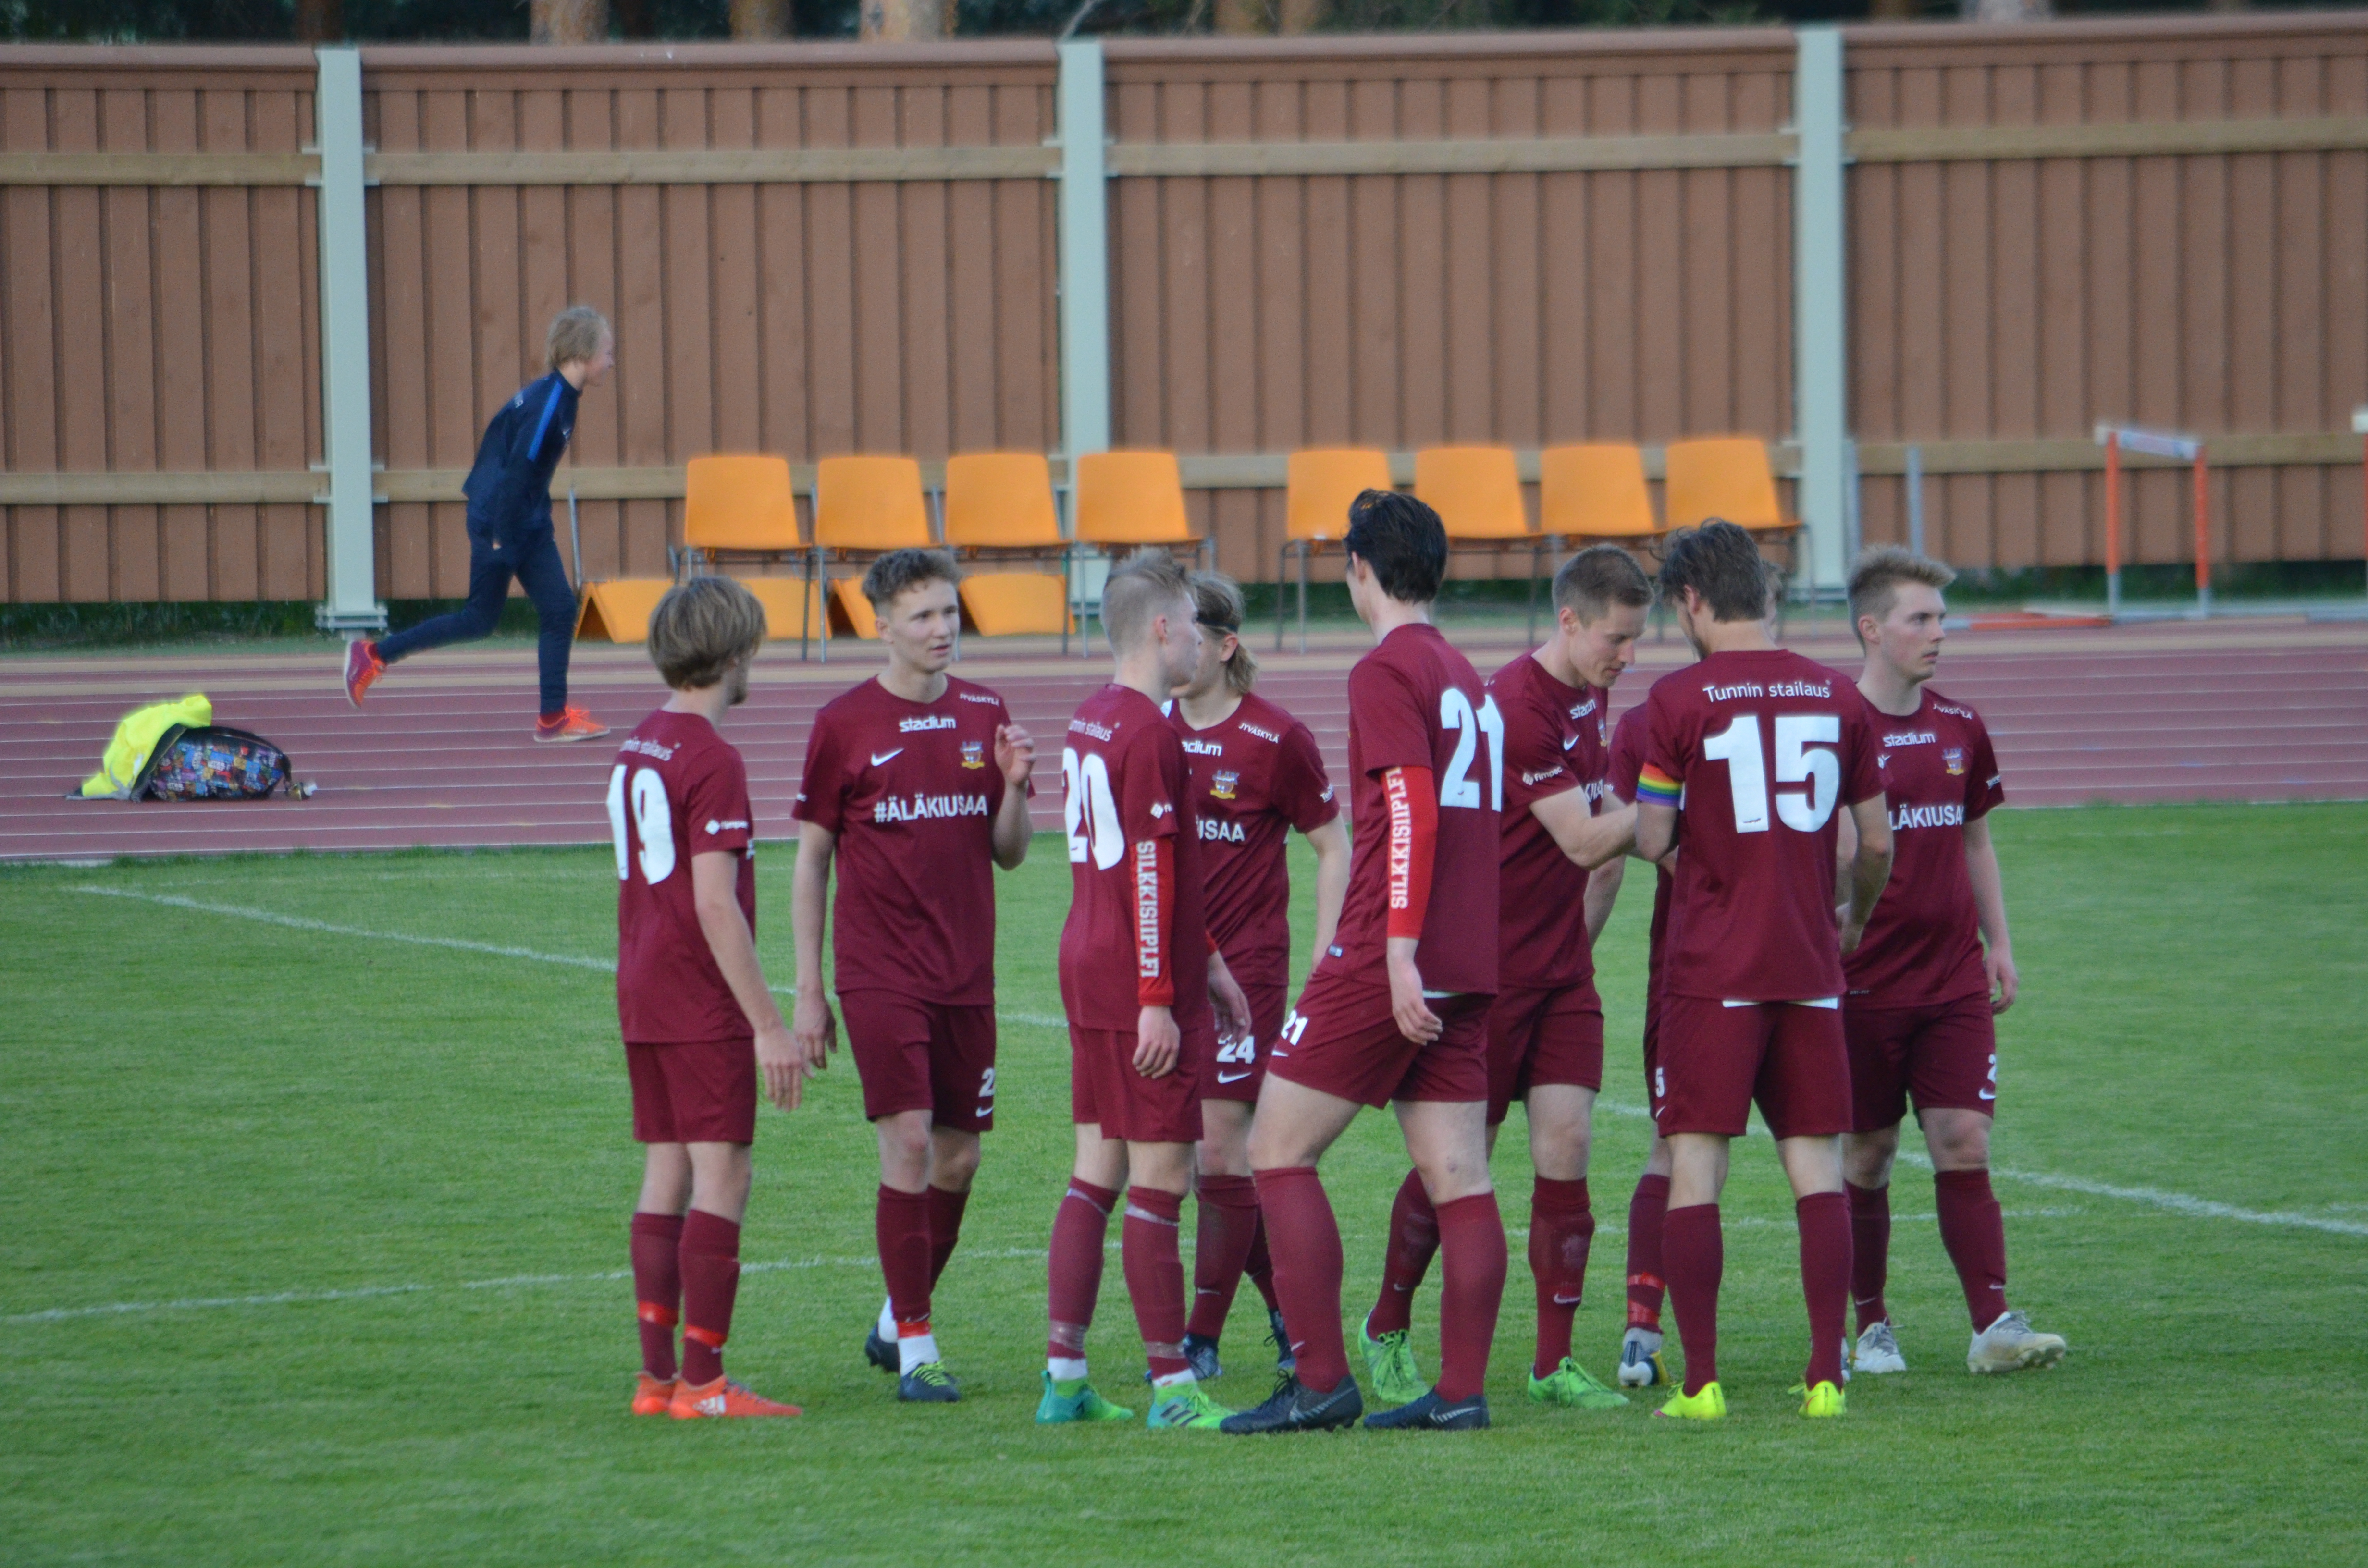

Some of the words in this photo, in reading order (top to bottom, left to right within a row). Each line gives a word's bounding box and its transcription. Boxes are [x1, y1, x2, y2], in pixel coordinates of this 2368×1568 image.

[1702, 682, 1763, 703] Tunnin
[1769, 681, 1830, 698] stailaus
[899, 716, 957, 733] stadium
[1238, 723, 1280, 743] JYVÄSKYLÄ
[1883, 732, 1936, 747] stadium
[1440, 688, 1504, 812] 21
[1534, 767, 1563, 782] fimpec
[1703, 715, 1840, 833] 15
[874, 792, 988, 823] #ÄLÄKIUSAA
[1062, 747, 1125, 871] 20
[606, 764, 676, 884] 19
[1216, 1033, 1256, 1064] 24
